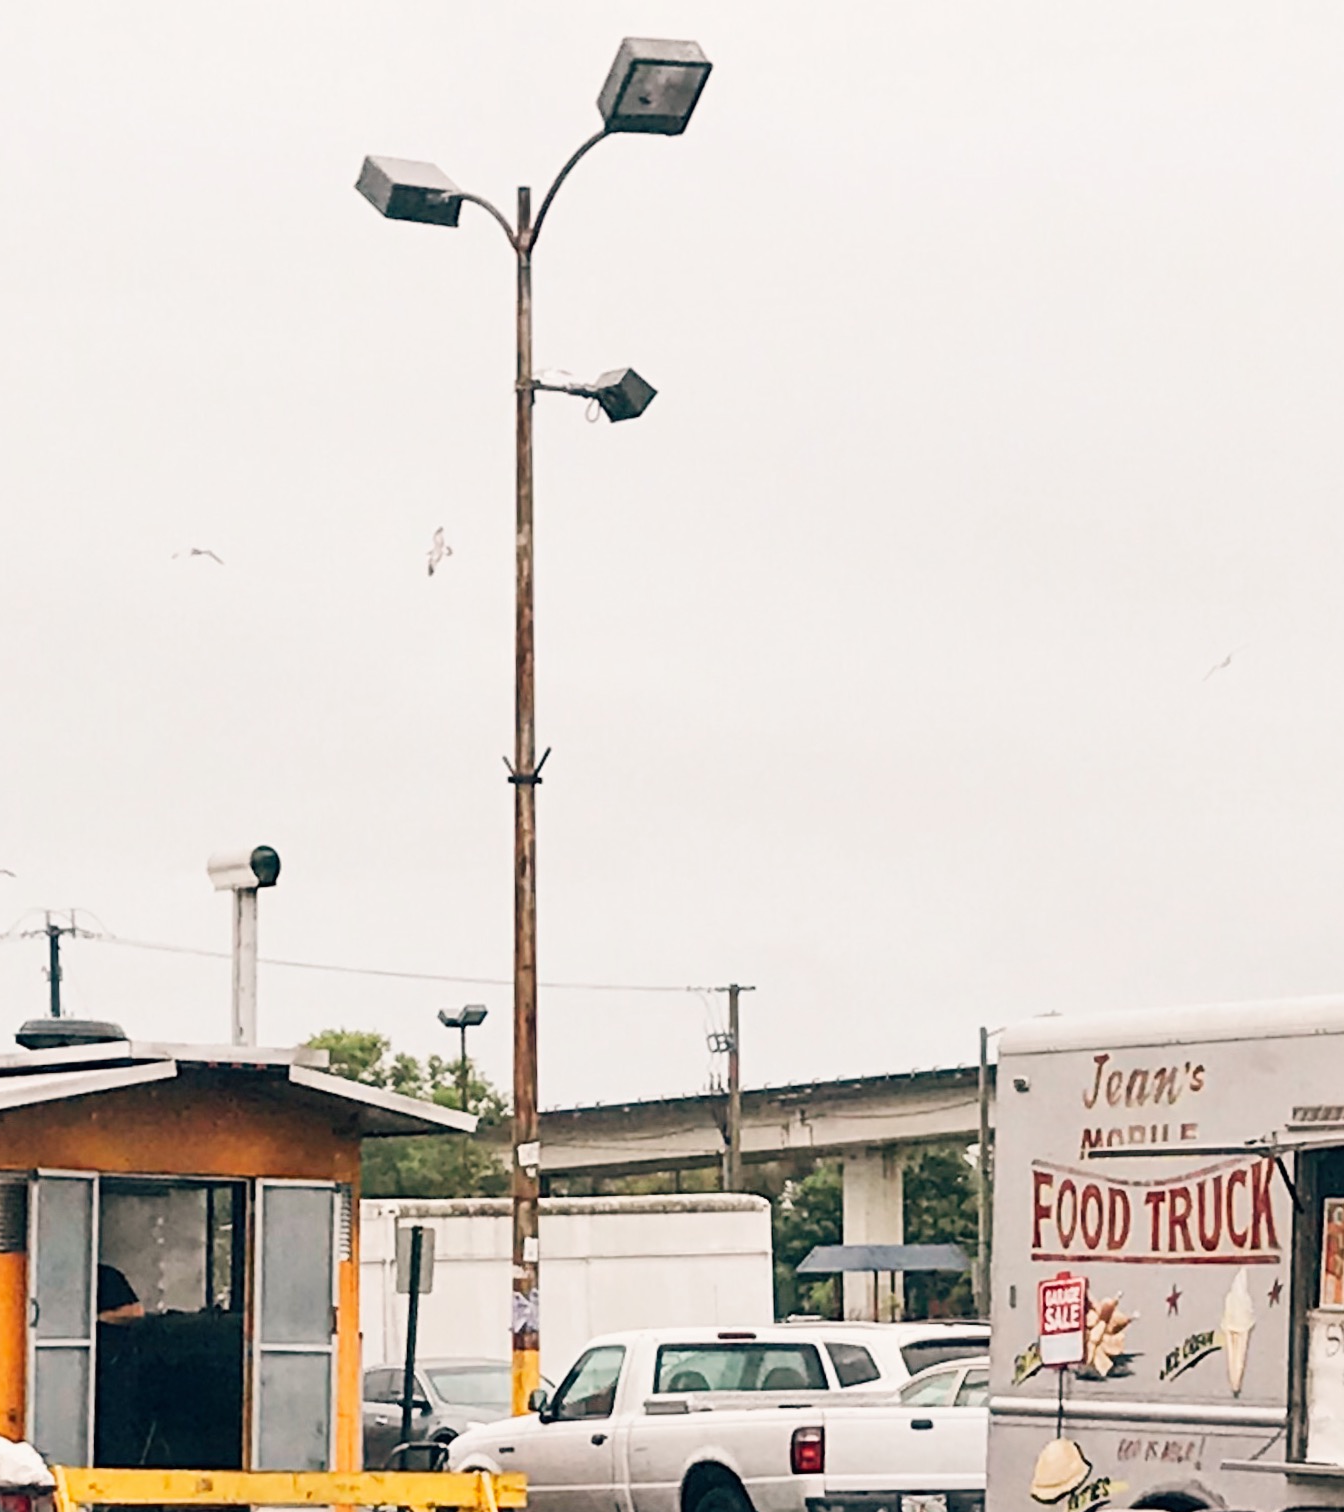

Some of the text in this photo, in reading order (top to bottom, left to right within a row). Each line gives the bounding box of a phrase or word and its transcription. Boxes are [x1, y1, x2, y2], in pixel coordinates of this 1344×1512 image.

[1083, 1053, 1205, 1110] Jean's
[1031, 1156, 1281, 1251] FOOD TRUCK
[1044, 1303, 1081, 1332] SALE
